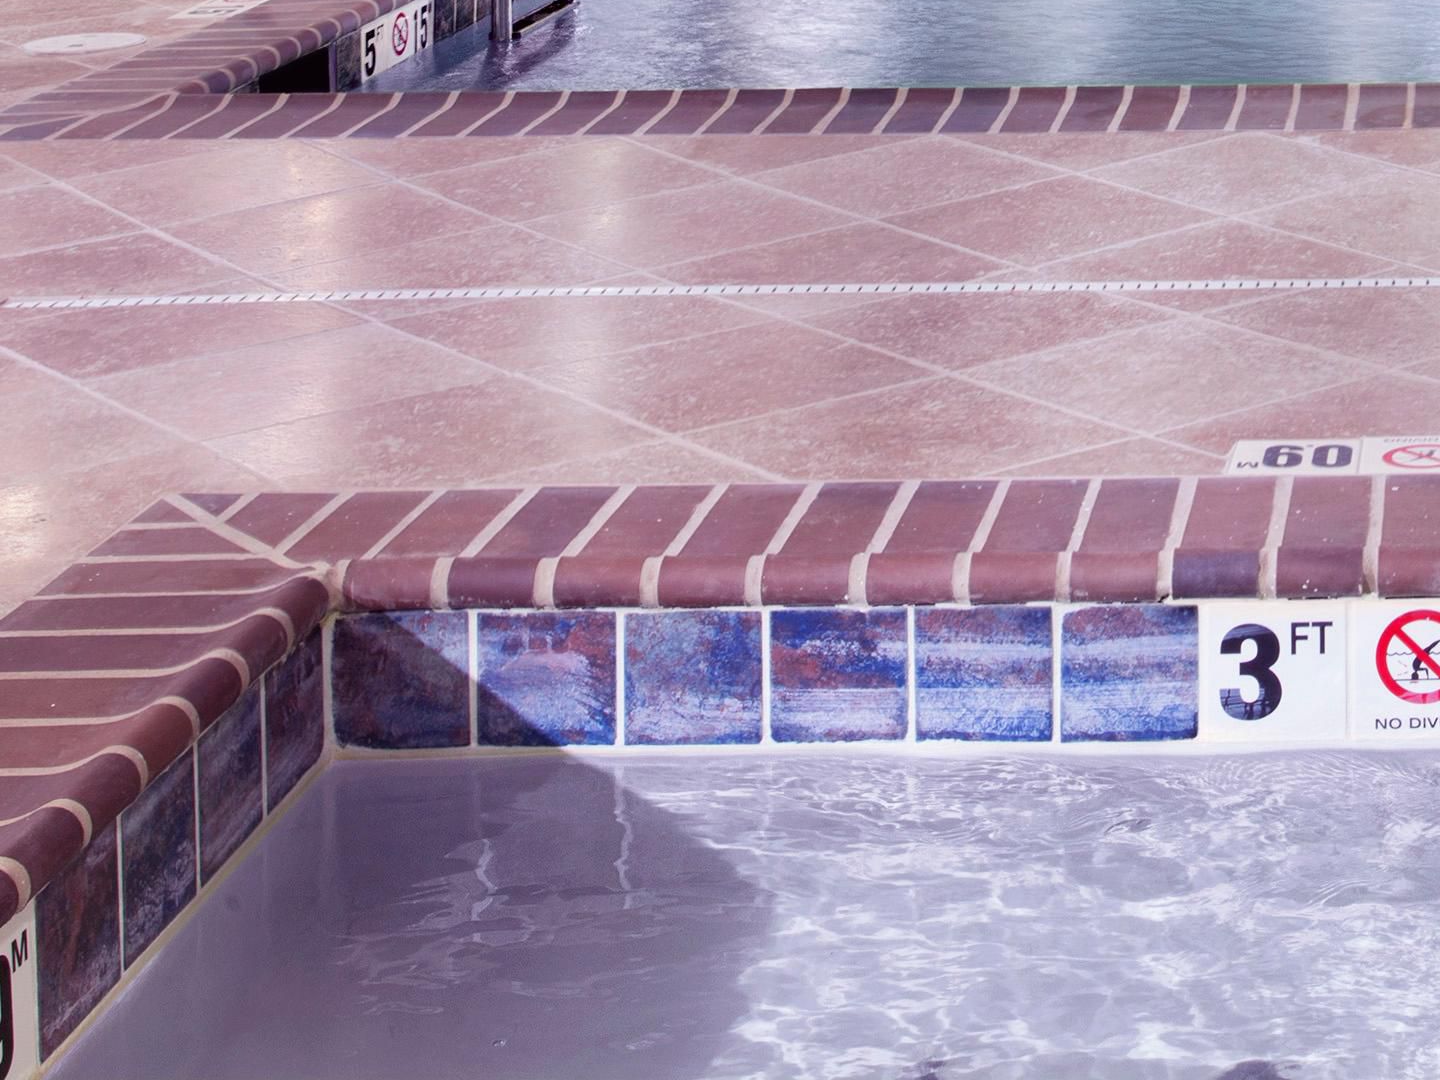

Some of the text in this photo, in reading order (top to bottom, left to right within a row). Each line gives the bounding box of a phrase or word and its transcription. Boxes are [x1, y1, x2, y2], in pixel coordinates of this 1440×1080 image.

[365, 28, 376, 77] 5
[1220, 621, 1333, 721] 3 FT
[1375, 718, 1403, 730] NO
[11, 928, 29, 973] M
